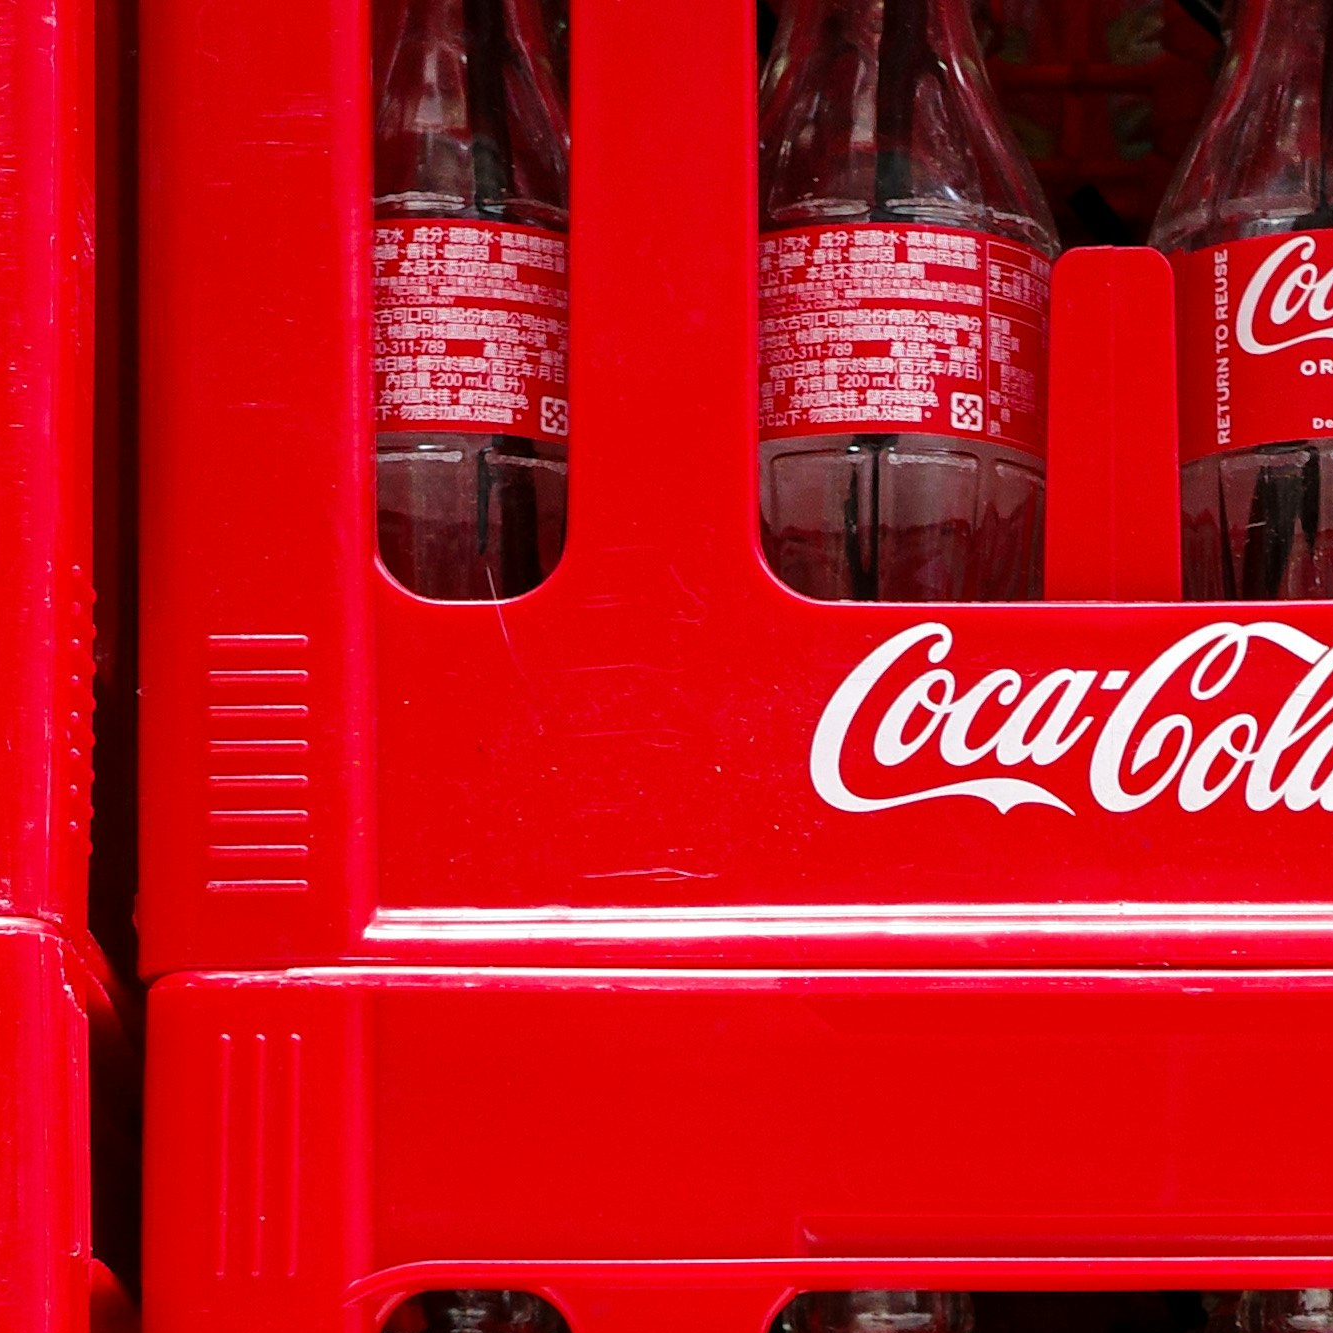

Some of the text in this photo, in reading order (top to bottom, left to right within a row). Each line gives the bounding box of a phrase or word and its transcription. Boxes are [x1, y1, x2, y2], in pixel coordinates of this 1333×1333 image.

[1214, 249, 1231, 444] RETURN TO REUSE
